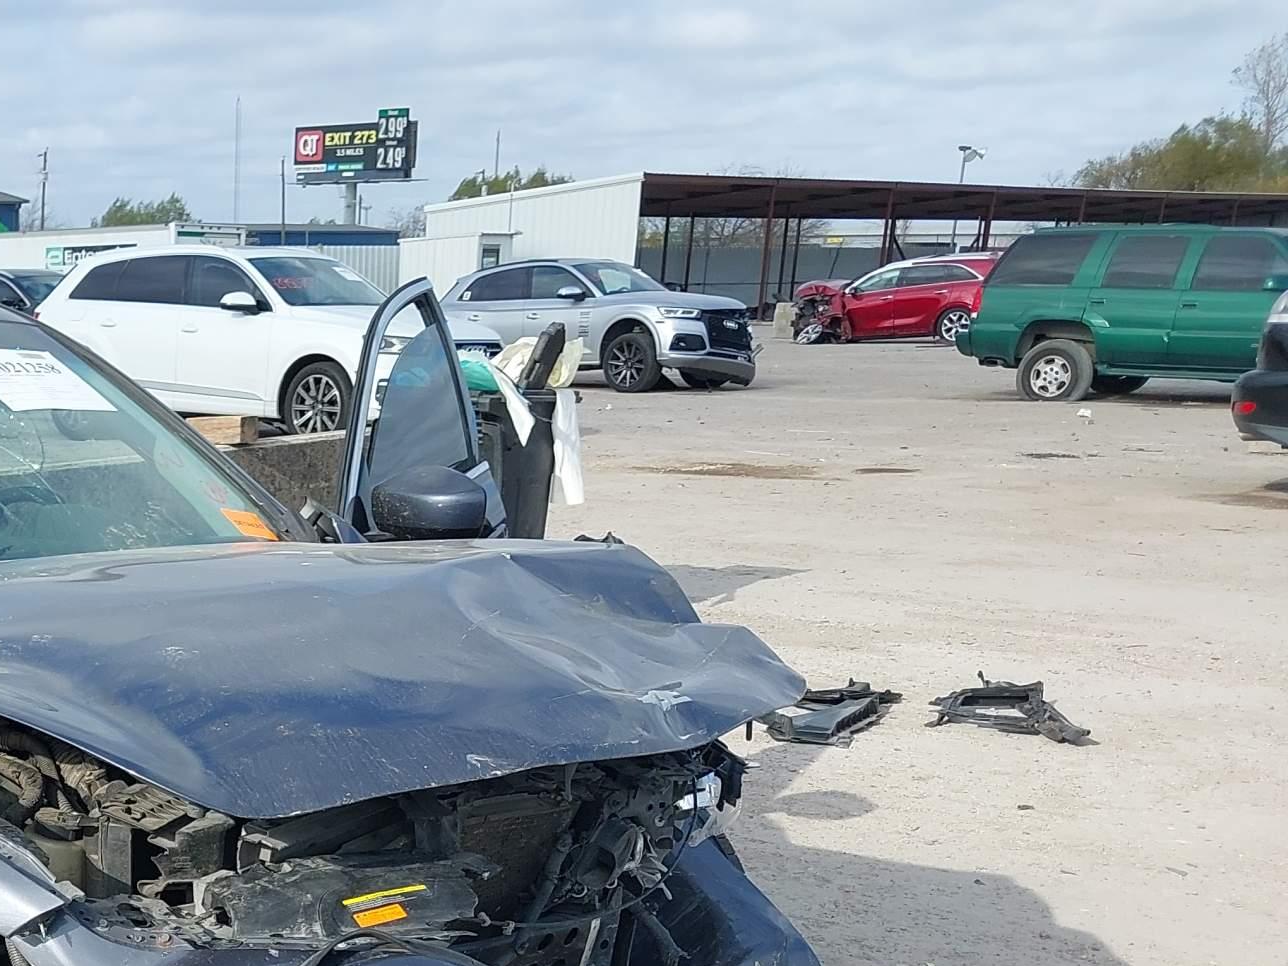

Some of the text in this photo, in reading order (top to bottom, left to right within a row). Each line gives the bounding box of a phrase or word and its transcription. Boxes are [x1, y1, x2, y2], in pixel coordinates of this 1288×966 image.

[298, 134, 320, 157] QT
[324, 130, 377, 146] EXIT 273
